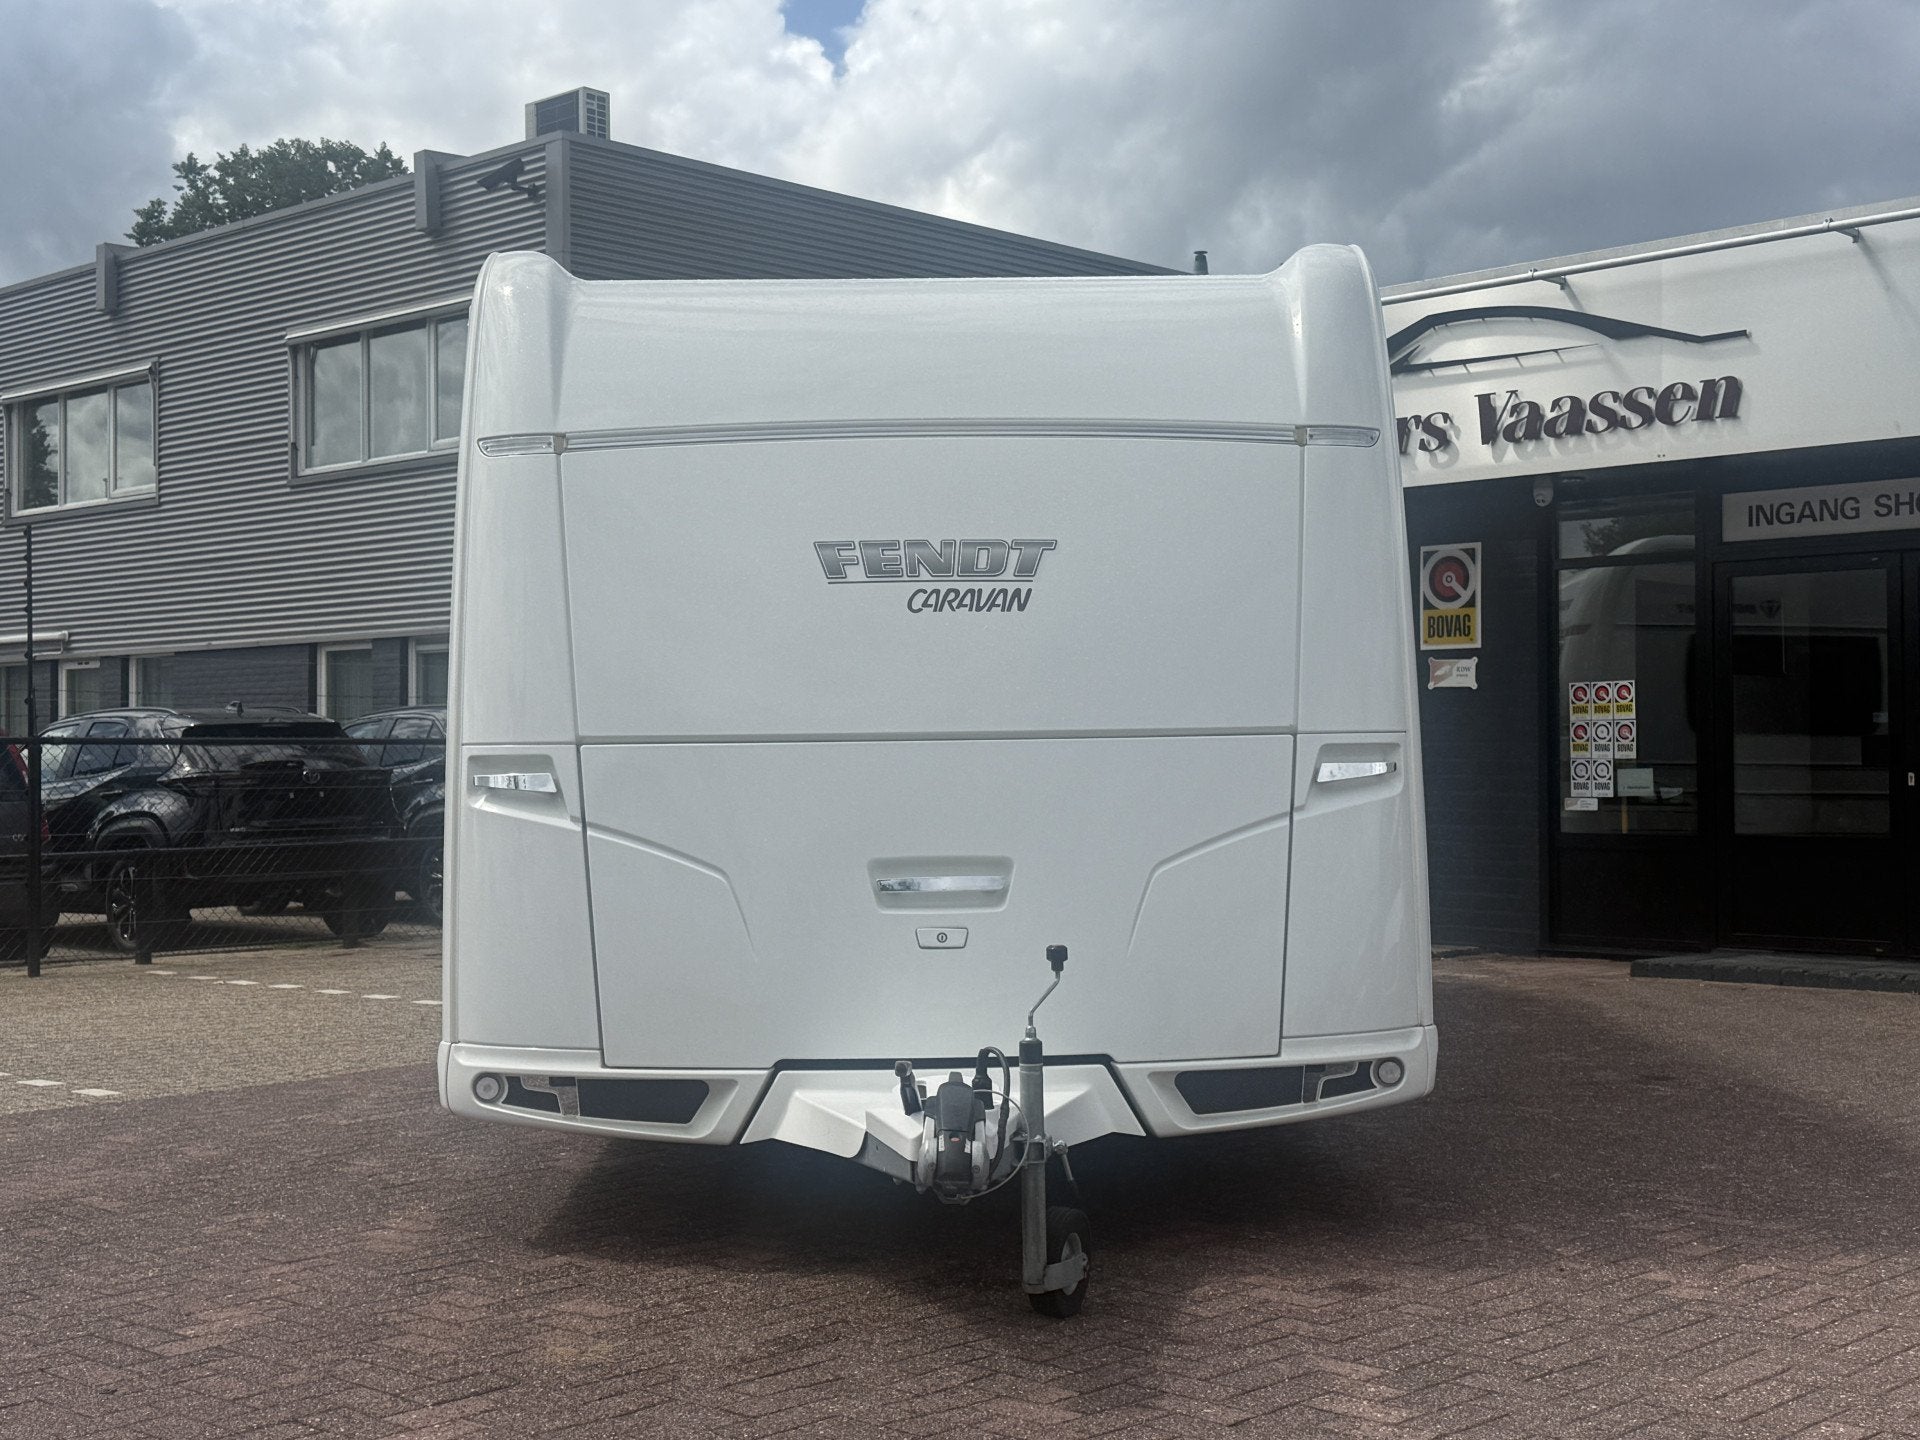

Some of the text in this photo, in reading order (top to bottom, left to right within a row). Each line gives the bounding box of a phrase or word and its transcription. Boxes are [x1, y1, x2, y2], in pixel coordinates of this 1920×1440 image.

[1474, 375, 1744, 446] Vaassen
[1748, 491, 1920, 528] INGANG SH
[813, 539, 1058, 579] FENDT
[907, 587, 1033, 614] CARAVAN
[1427, 613, 1472, 639] BOVAG
[1572, 704, 1589, 715] BOVAG
[1594, 704, 1611, 714] BOVAG
[1616, 703, 1633, 713] BOVAG
[1572, 743, 1589, 752] BOVAG
[1594, 743, 1611, 752] BOVAG
[1617, 743, 1634, 752] BOVAG
[1573, 782, 1590, 791] BOVAG
[1594, 782, 1611, 791] BOVAG
